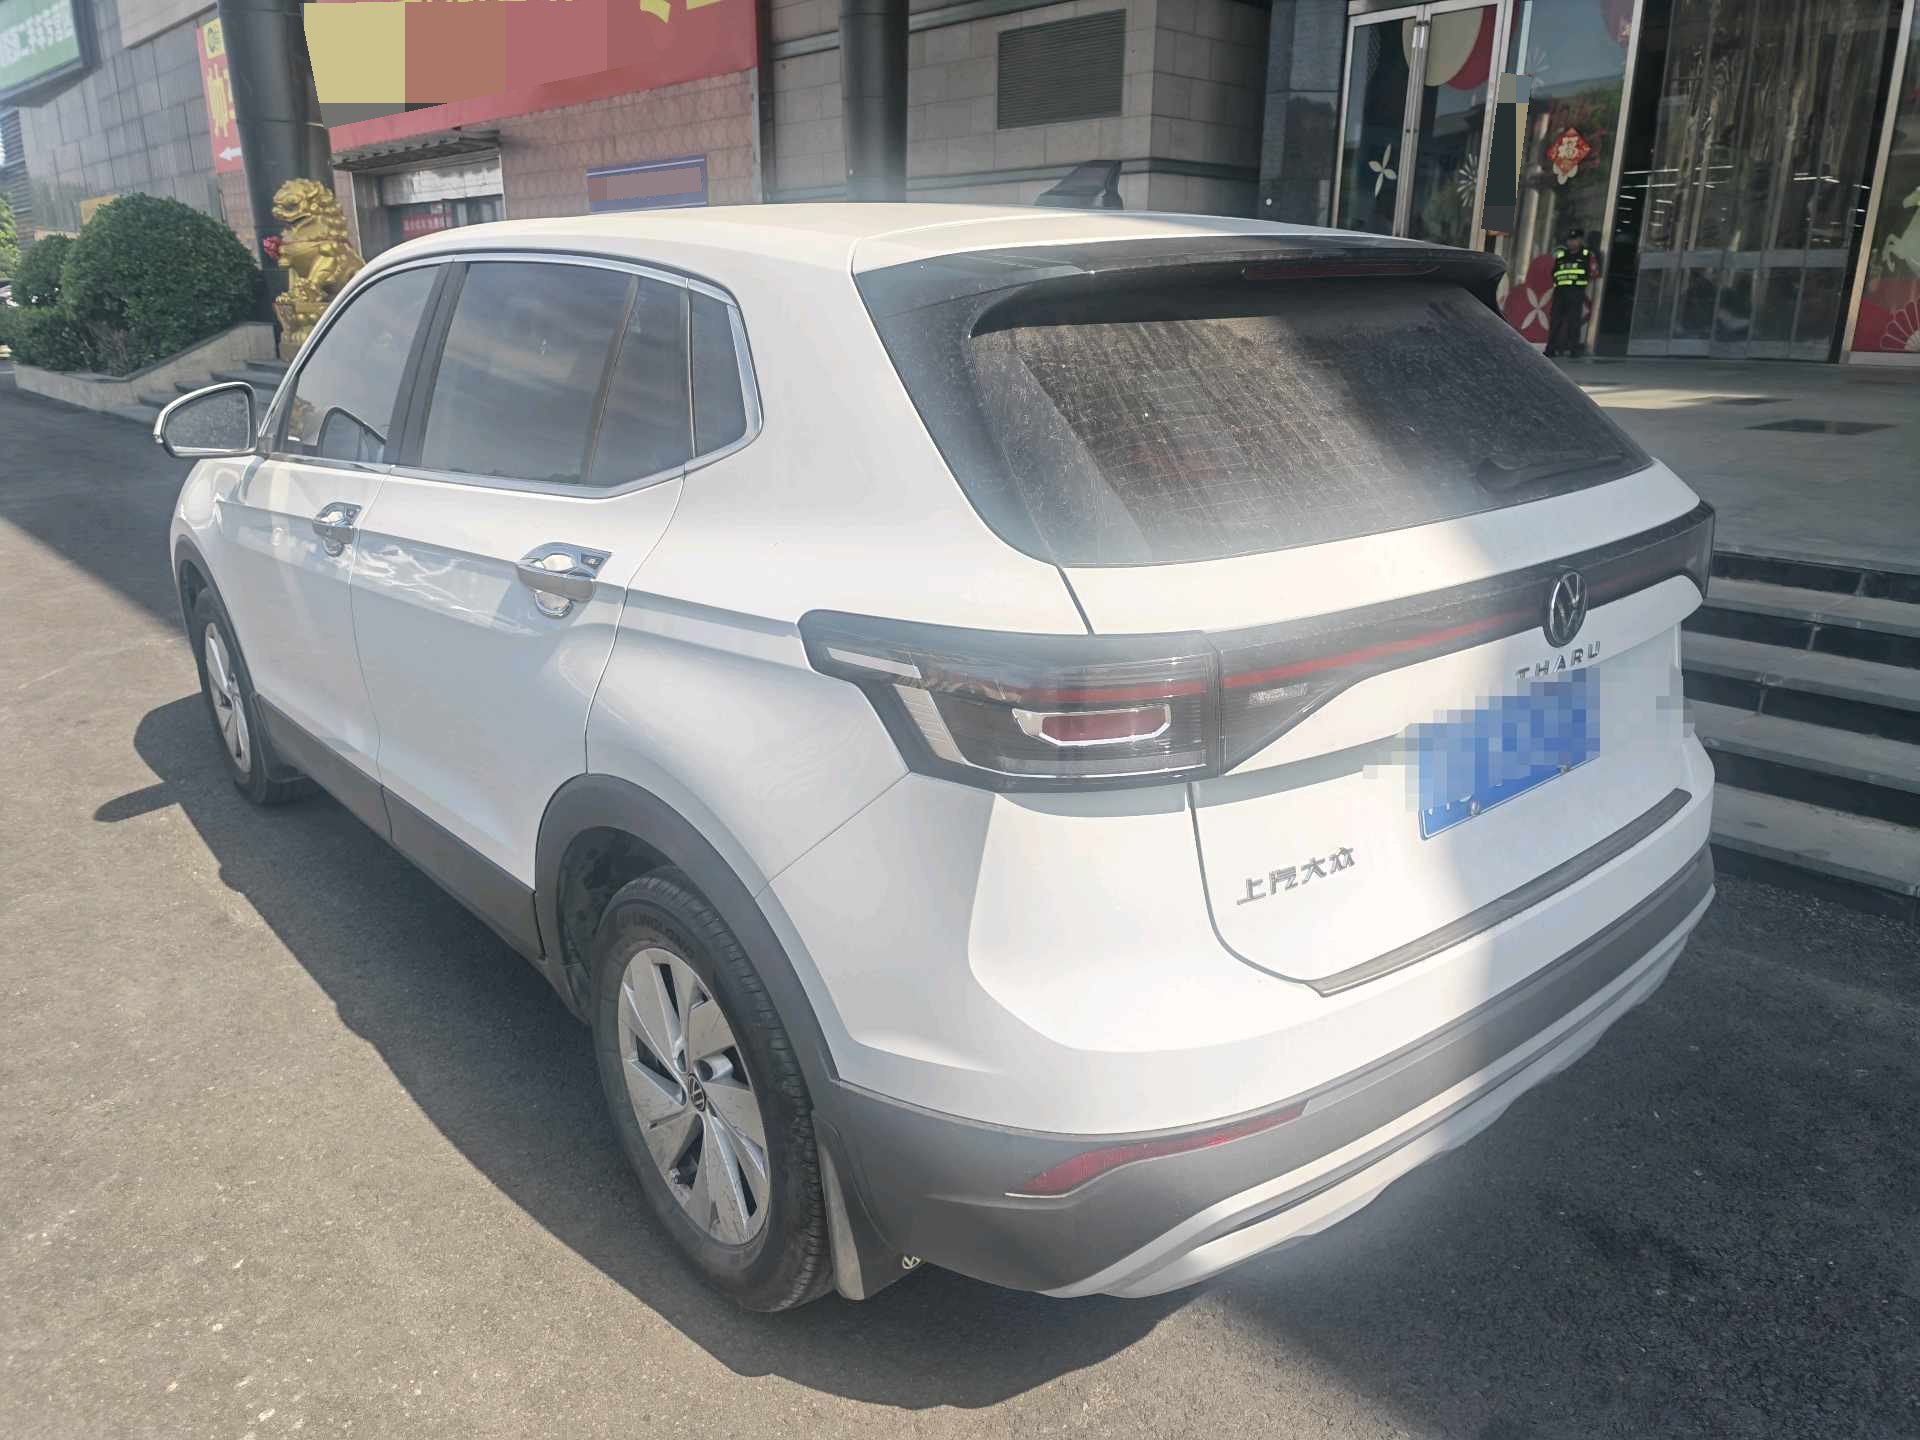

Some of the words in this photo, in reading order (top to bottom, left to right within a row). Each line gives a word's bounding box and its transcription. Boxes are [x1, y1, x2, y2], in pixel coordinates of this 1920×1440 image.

[1515, 641, 1601, 681] THARU
[1237, 847, 1355, 905] 上汽大众
